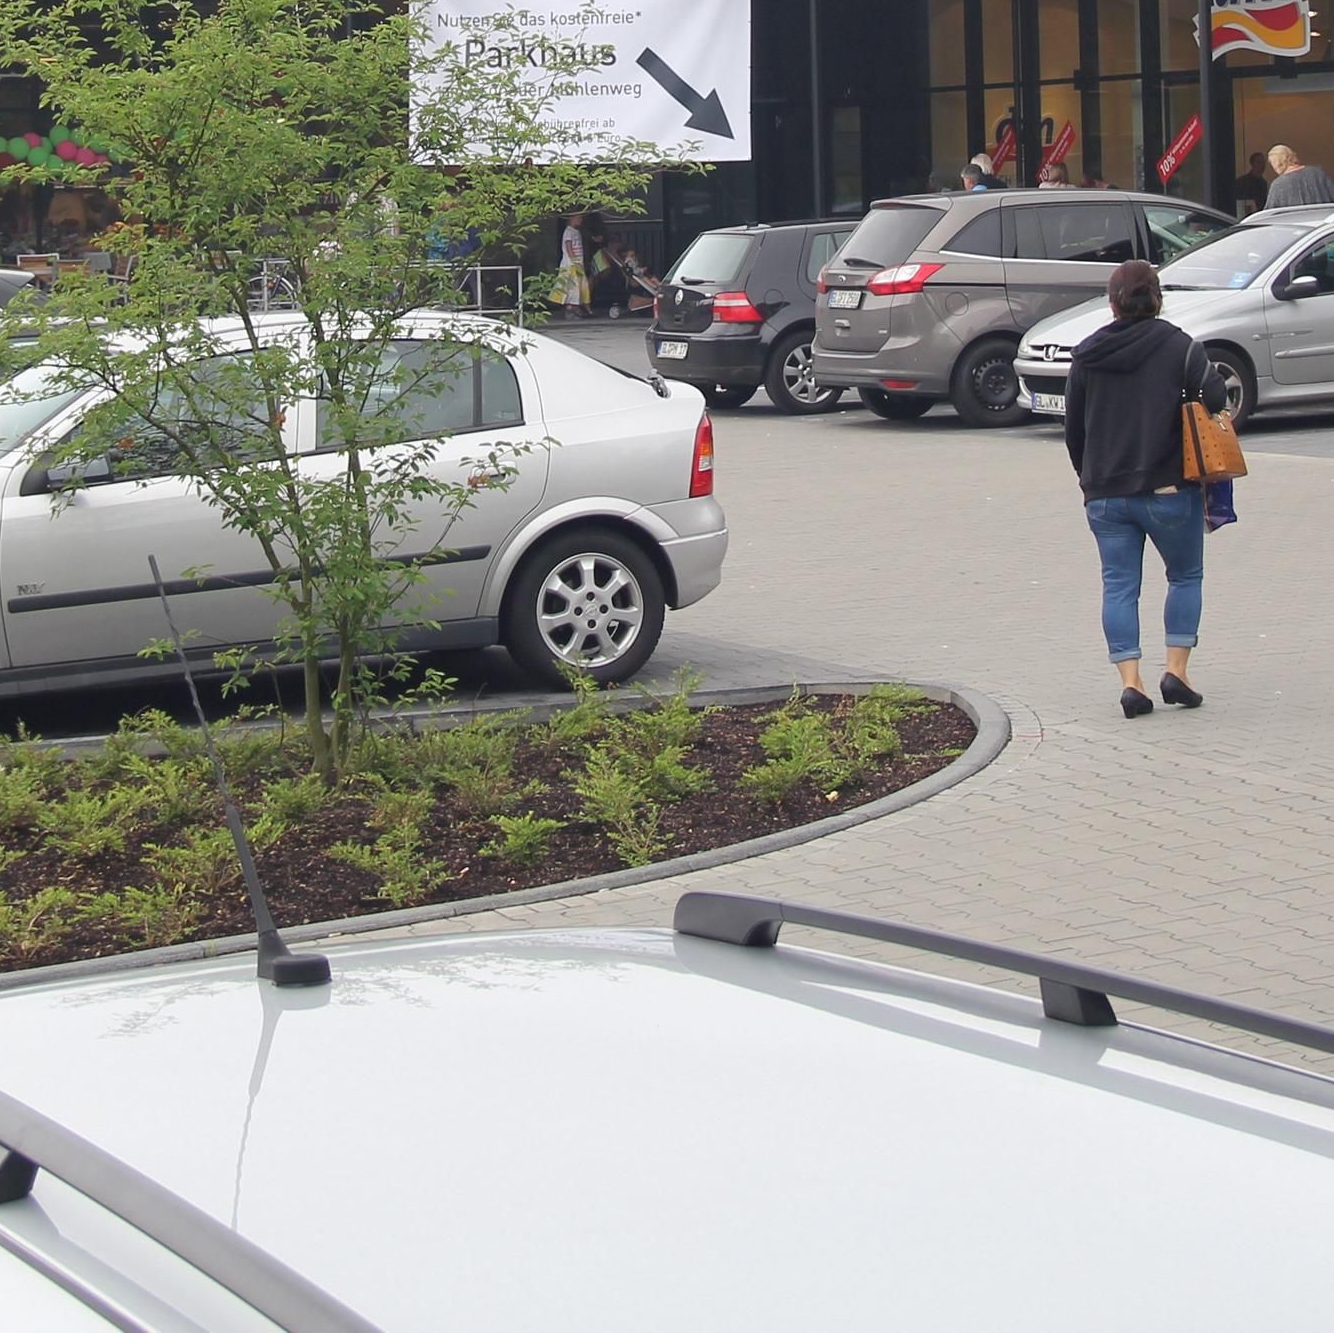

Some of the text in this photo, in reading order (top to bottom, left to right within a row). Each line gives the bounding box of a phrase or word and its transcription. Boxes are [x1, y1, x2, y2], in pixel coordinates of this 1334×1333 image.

[437, 12, 490, 28] Nutzen
[520, 10, 546, 27] das
[464, 38, 617, 69] Parkhaus
[602, 118, 615, 128] ab
[1160, 154, 1176, 177] 10%
